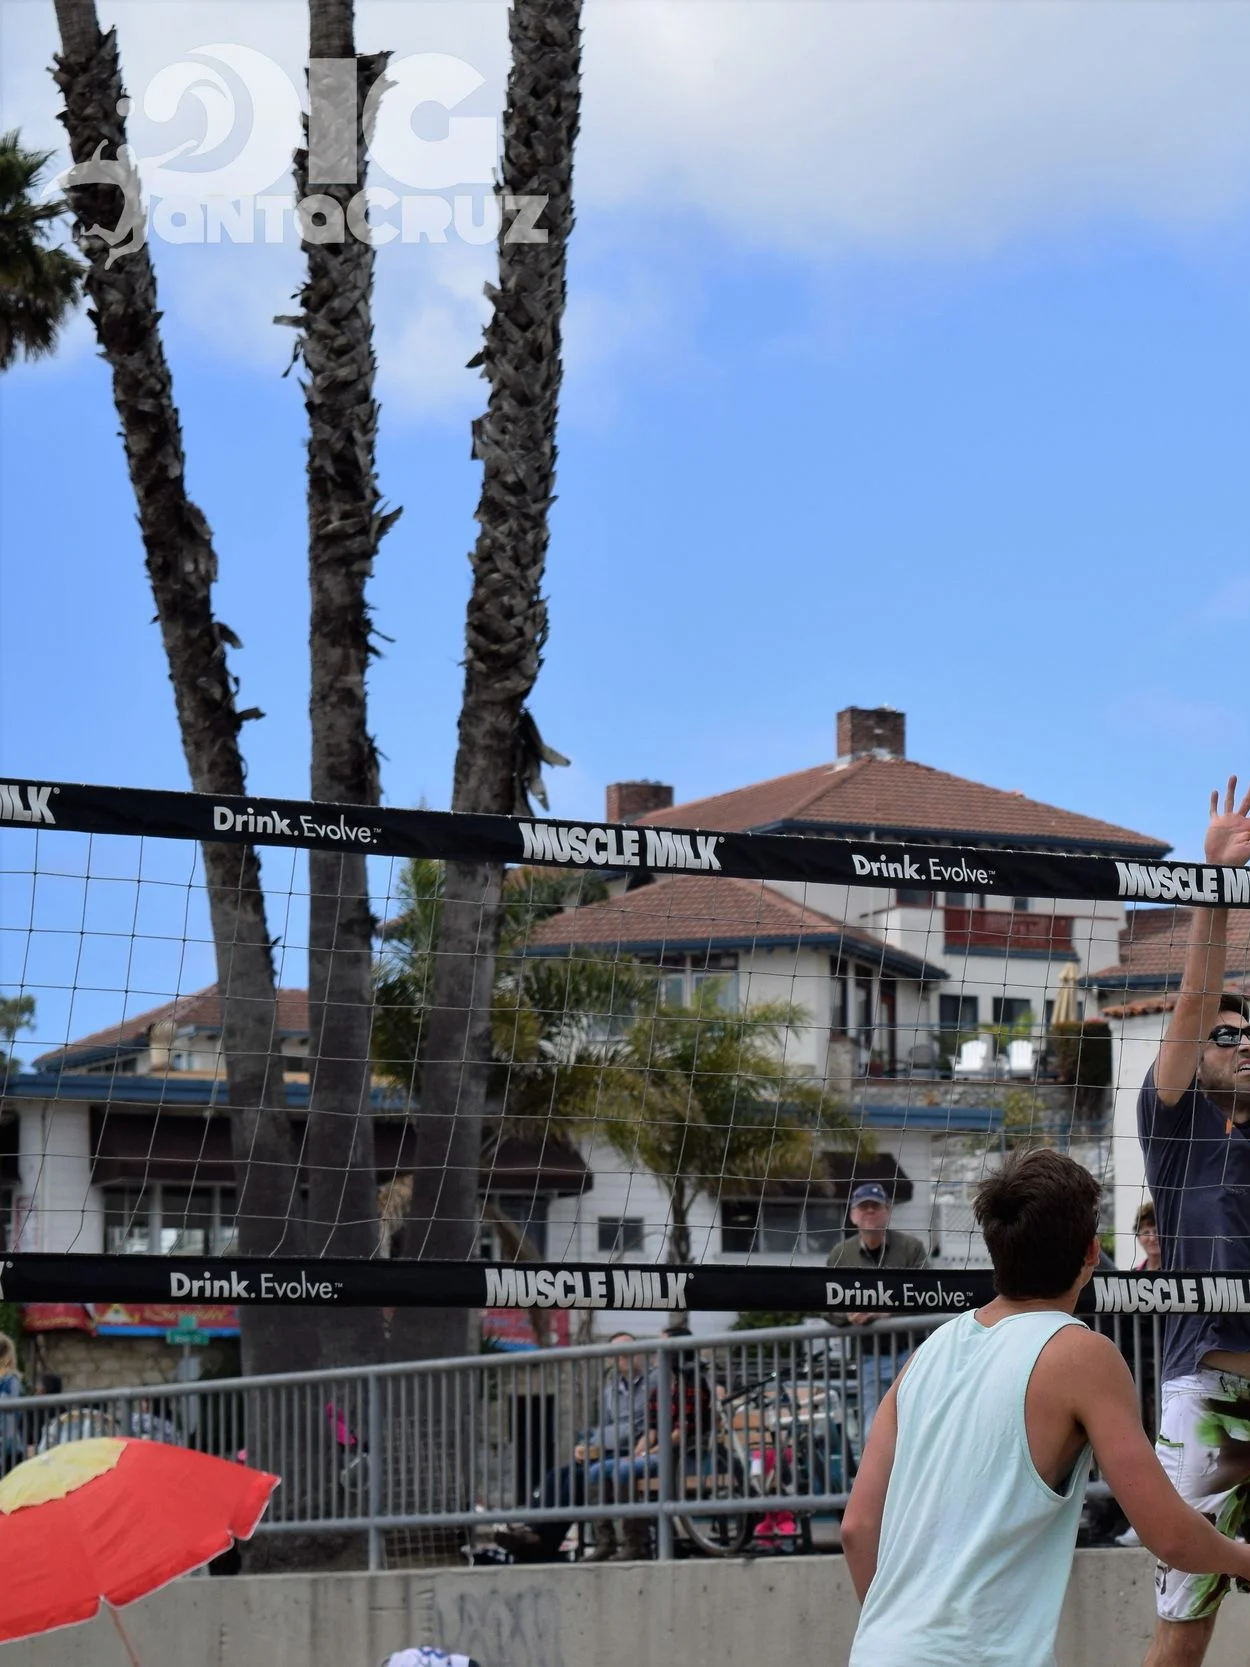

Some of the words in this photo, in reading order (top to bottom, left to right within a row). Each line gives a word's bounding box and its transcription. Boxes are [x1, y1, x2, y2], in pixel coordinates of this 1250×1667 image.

[213, 806, 299, 836] Drink.
[518, 822, 640, 865] MUSCLE
[851, 854, 927, 880] Drink.
[1114, 861, 1219, 903] MUSCLE
[170, 1271, 256, 1298] Drink.
[485, 1268, 608, 1308] MUSCLE
[825, 1281, 899, 1306] Drink.
[1094, 1277, 1199, 1313] MUSCLE
